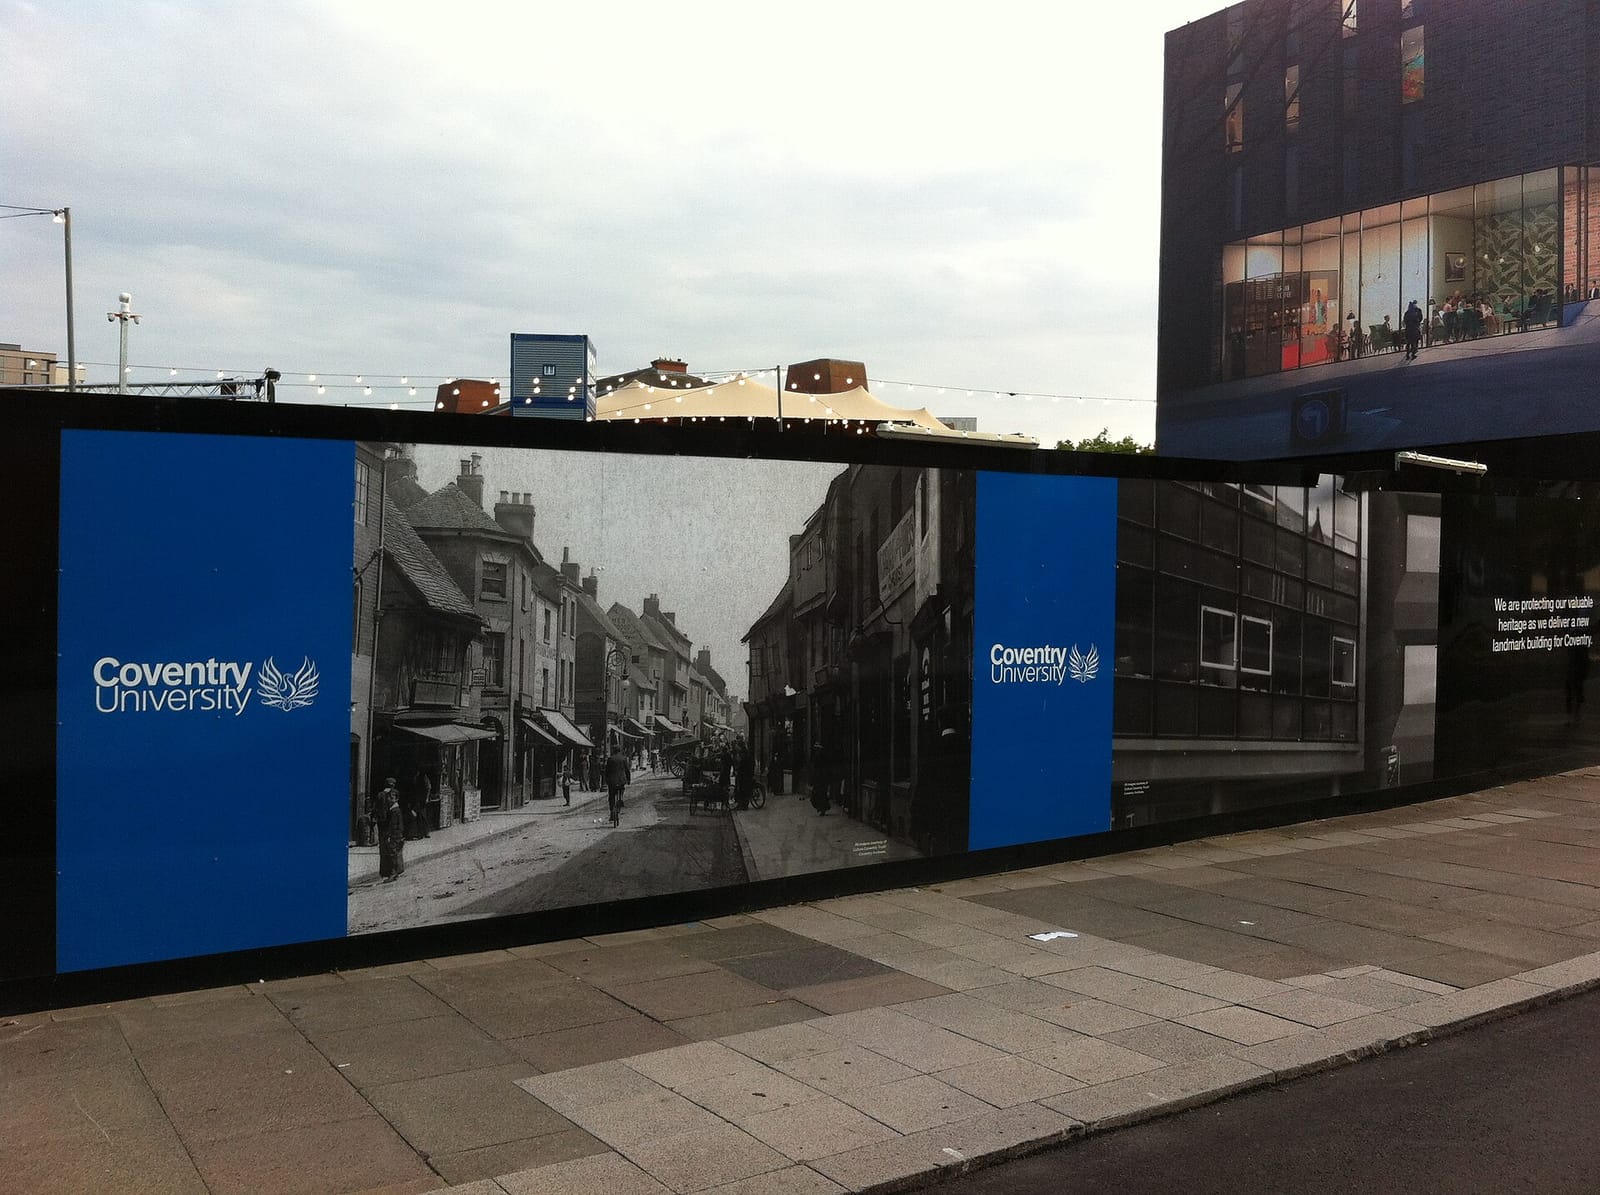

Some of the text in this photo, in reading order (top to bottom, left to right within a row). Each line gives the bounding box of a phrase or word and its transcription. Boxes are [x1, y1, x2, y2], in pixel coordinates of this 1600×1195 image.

[1494, 596, 1594, 613] We are protecting our valuable
[1498, 618, 1527, 633] heritage
[1528, 619, 1537, 630] as
[1537, 619, 1547, 630] we
[1548, 616, 1571, 629] deliver
[1576, 617, 1590, 627] new
[1492, 633, 1593, 652] landmark building for Coventry.
[991, 644, 1067, 669] Coventry
[94, 657, 253, 693] Coventry
[992, 663, 1067, 686] University
[95, 685, 252, 716] University
